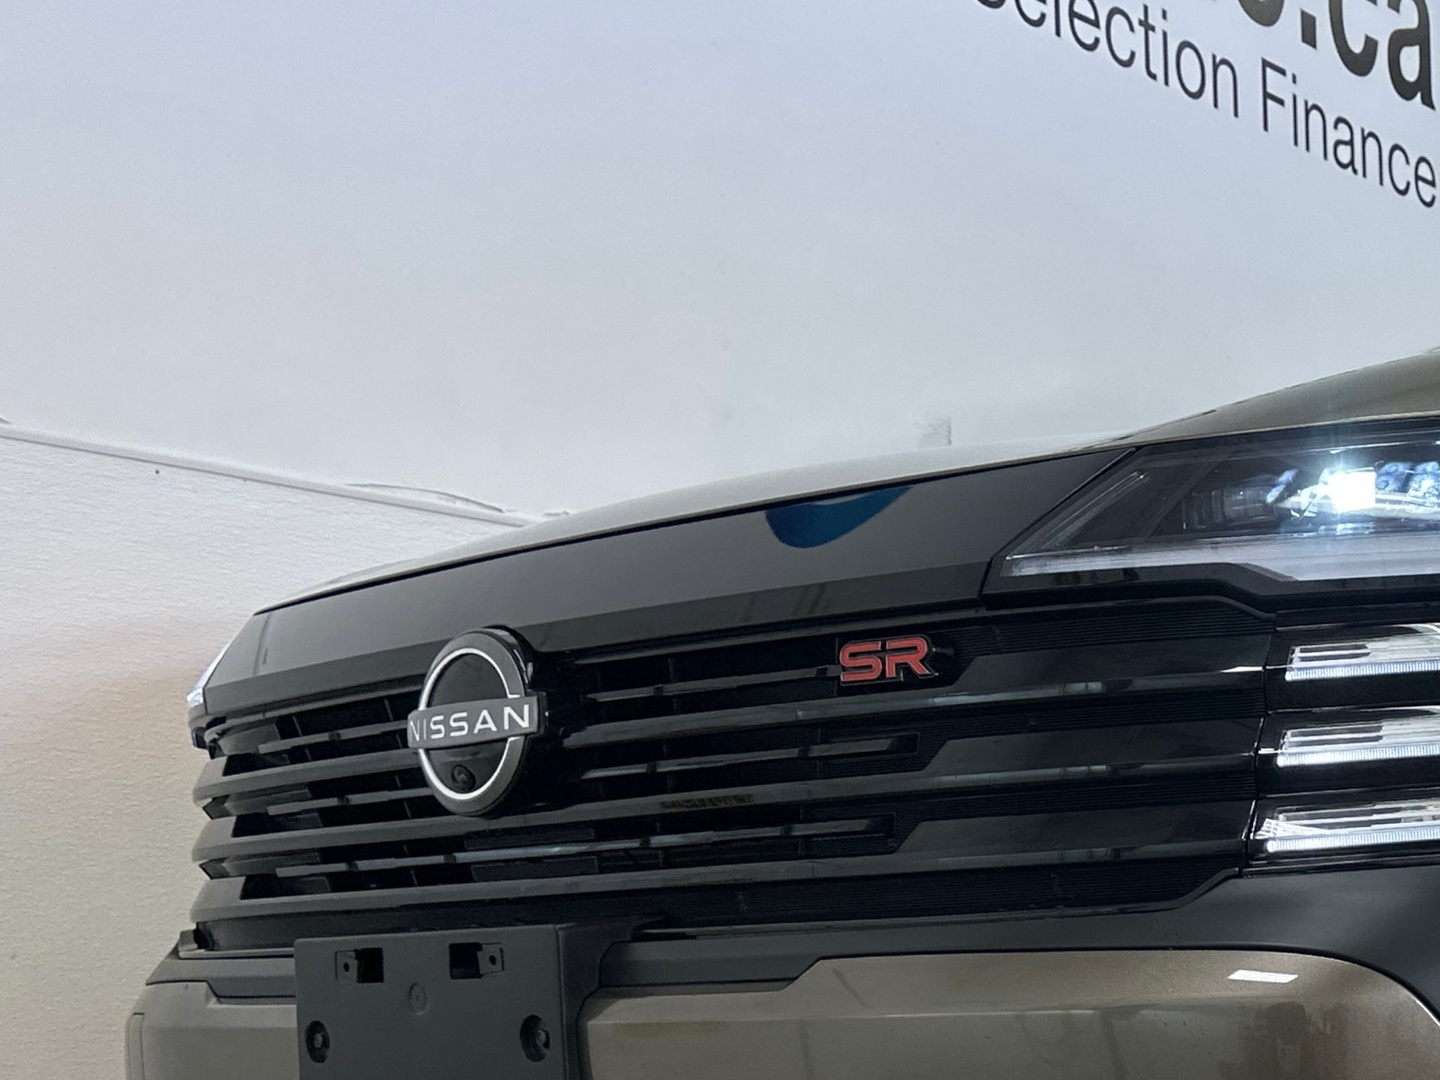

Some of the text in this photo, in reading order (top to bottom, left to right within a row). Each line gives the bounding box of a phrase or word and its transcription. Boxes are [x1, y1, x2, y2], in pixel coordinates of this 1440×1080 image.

[1238, 0, 1436, 111] .ca
[977, 0, 1437, 208] ection Finance
[840, 637, 931, 682] SR
[409, 704, 530, 742] NISSAN
